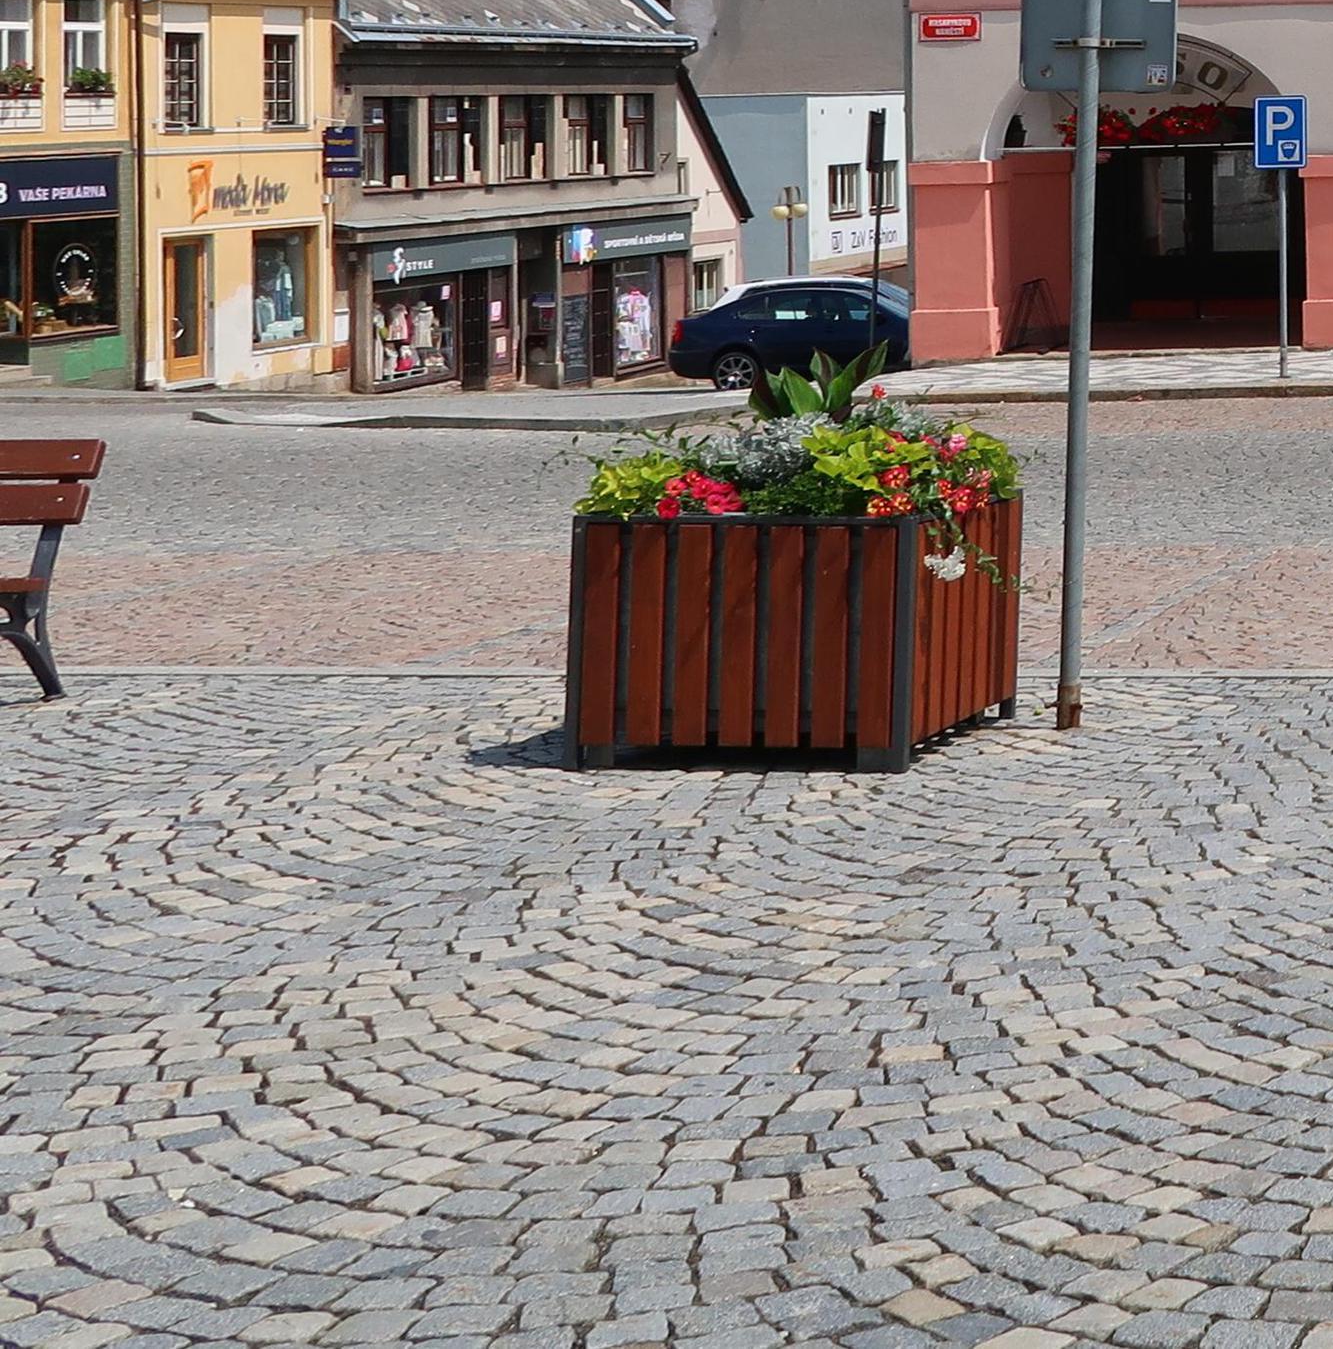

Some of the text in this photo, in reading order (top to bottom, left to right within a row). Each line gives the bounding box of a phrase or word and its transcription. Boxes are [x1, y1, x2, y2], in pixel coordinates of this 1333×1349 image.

[1266, 106, 1295, 146] P
[19, 187, 50, 202] VAŠE
[52, 185, 107, 200] PEKÁRNA
[405, 259, 434, 271] STYLE
